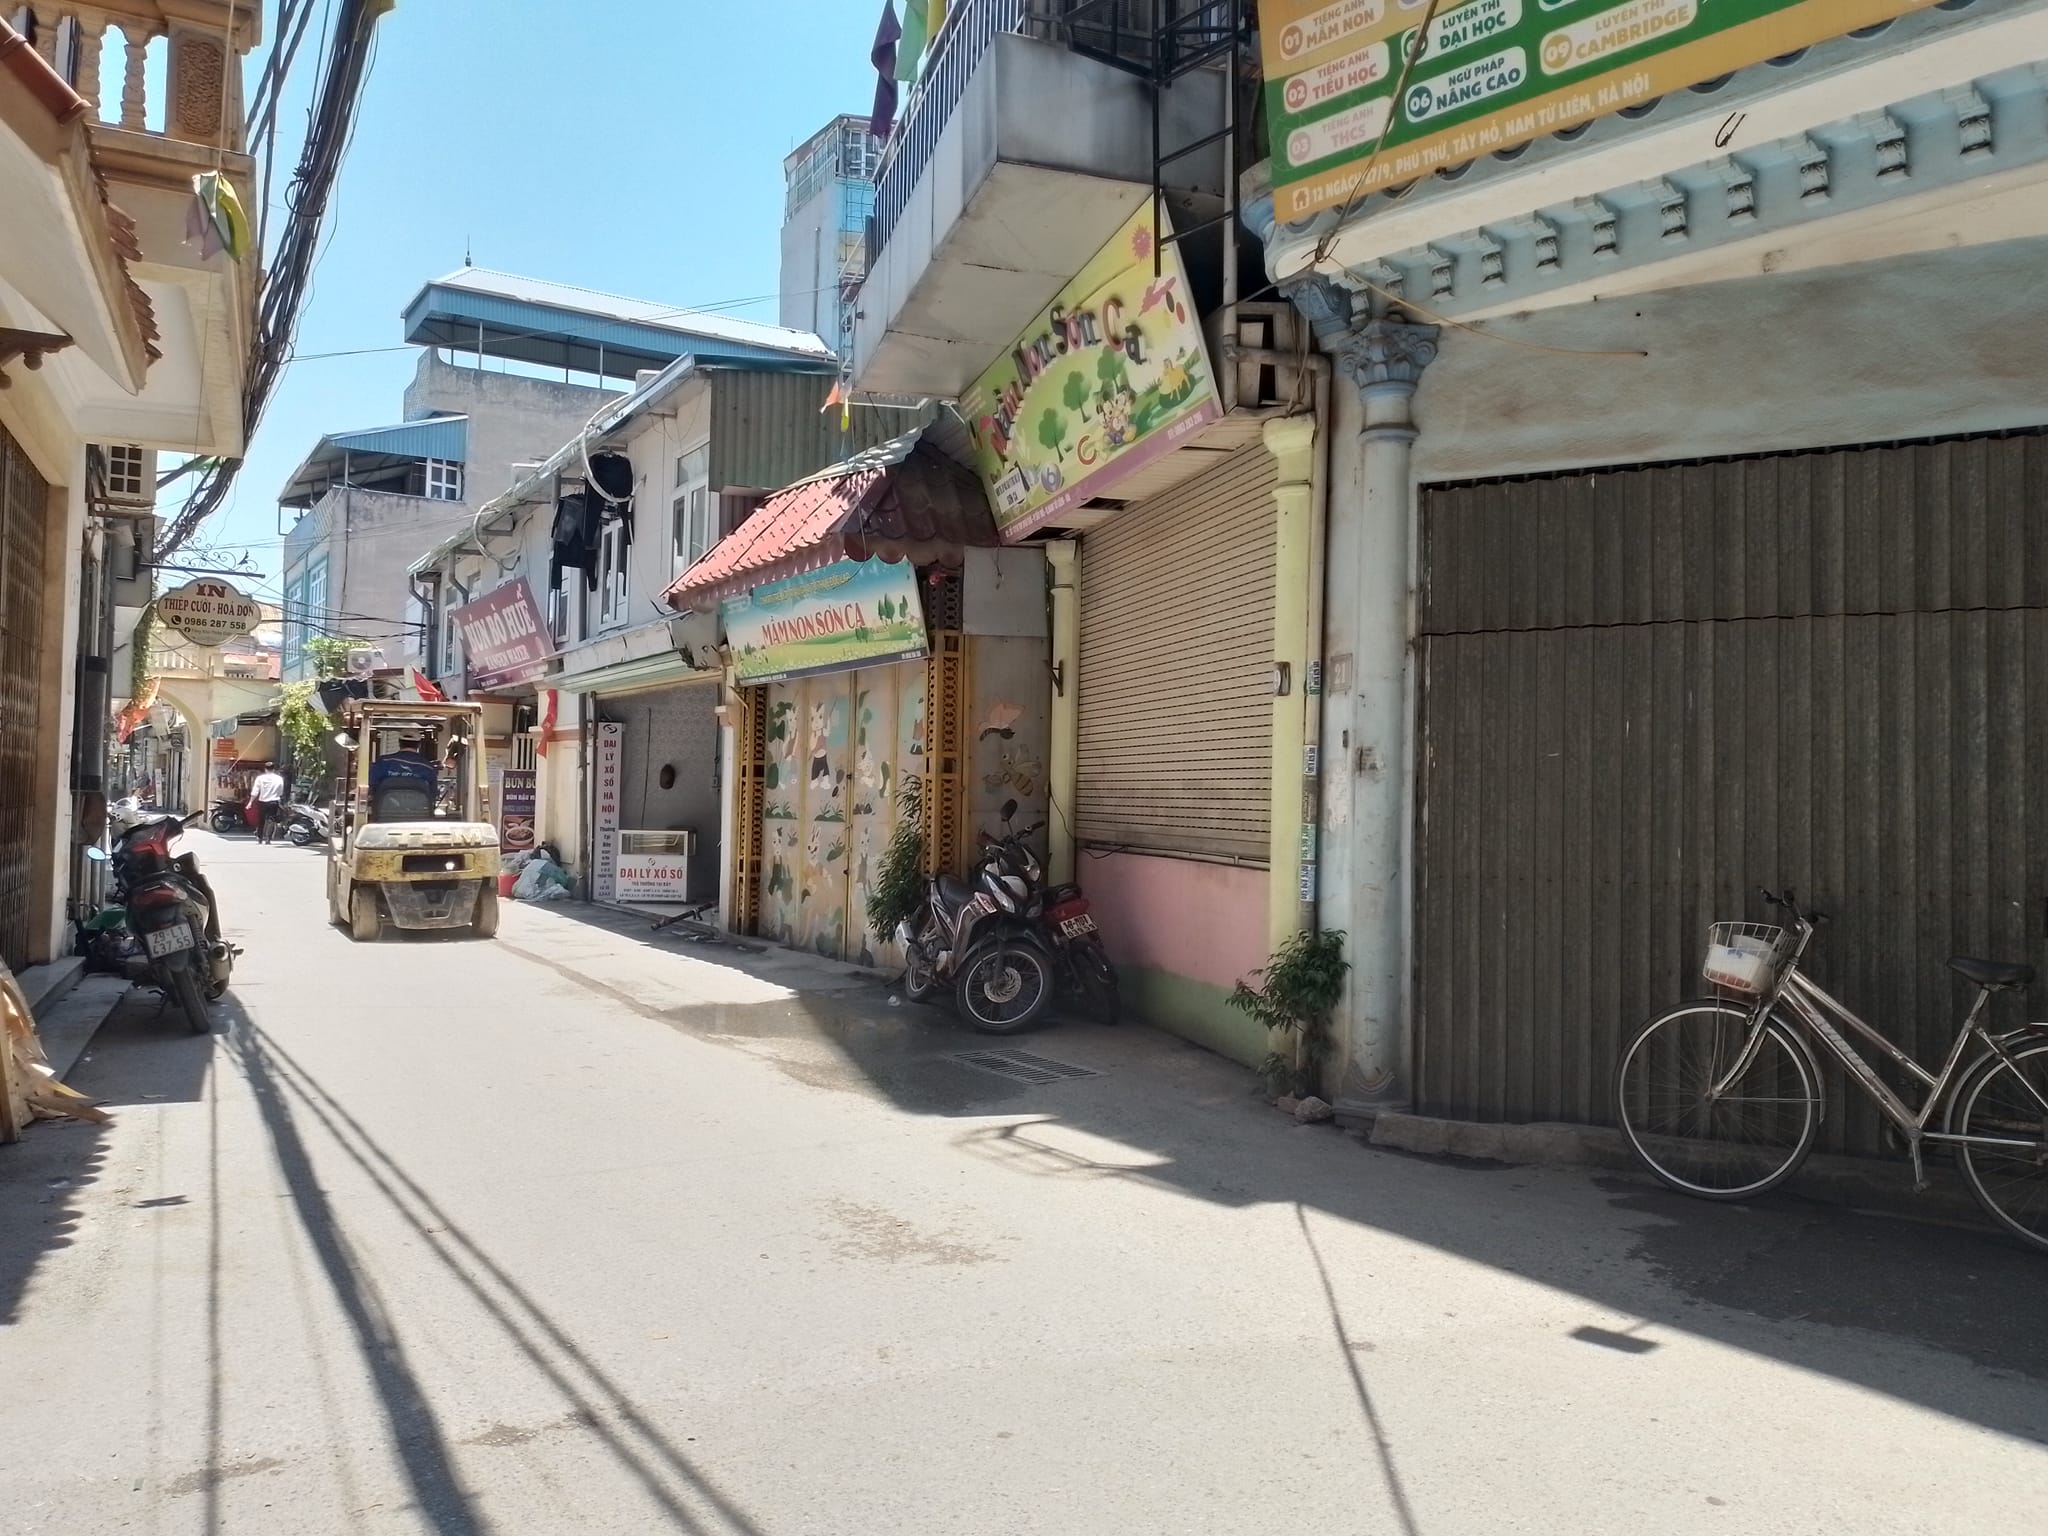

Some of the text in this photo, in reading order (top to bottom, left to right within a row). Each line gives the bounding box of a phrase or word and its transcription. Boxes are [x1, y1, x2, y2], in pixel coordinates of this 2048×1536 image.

[1343, 8, 1375, 31] NON
[1284, 31, 1300, 49] 01
[1440, 27, 1468, 50] ĐẠI
[1472, 12, 1506, 35] HỌC
[1575, 5, 1690, 59] CAMBRIDGE
[1348, 50, 1370, 66] ANH
[1545, 41, 1570, 62] 09
[1348, 63, 1378, 86] HỌC
[1474, 57, 1505, 78] PHÁP
[1288, 84, 1306, 100] 02
[1436, 67, 1521, 110] NÂNG CAO
[1409, 93, 1430, 111] 06
[1505, 117, 1536, 138] NAM
[1598, 83, 1619, 106] HÀ
[1623, 73, 1650, 98] NỘI
[1351, 106, 1374, 122] ANH
[1331, 126, 1366, 147] THCS
[1103, 298, 1145, 365] Ca
[196, 584, 227, 598] IN
[184, 617, 247, 630] 0986 287 558
[787, 612, 816, 640] NON
[844, 602, 866, 629] CA
[1334, 662, 1346, 684] 21
